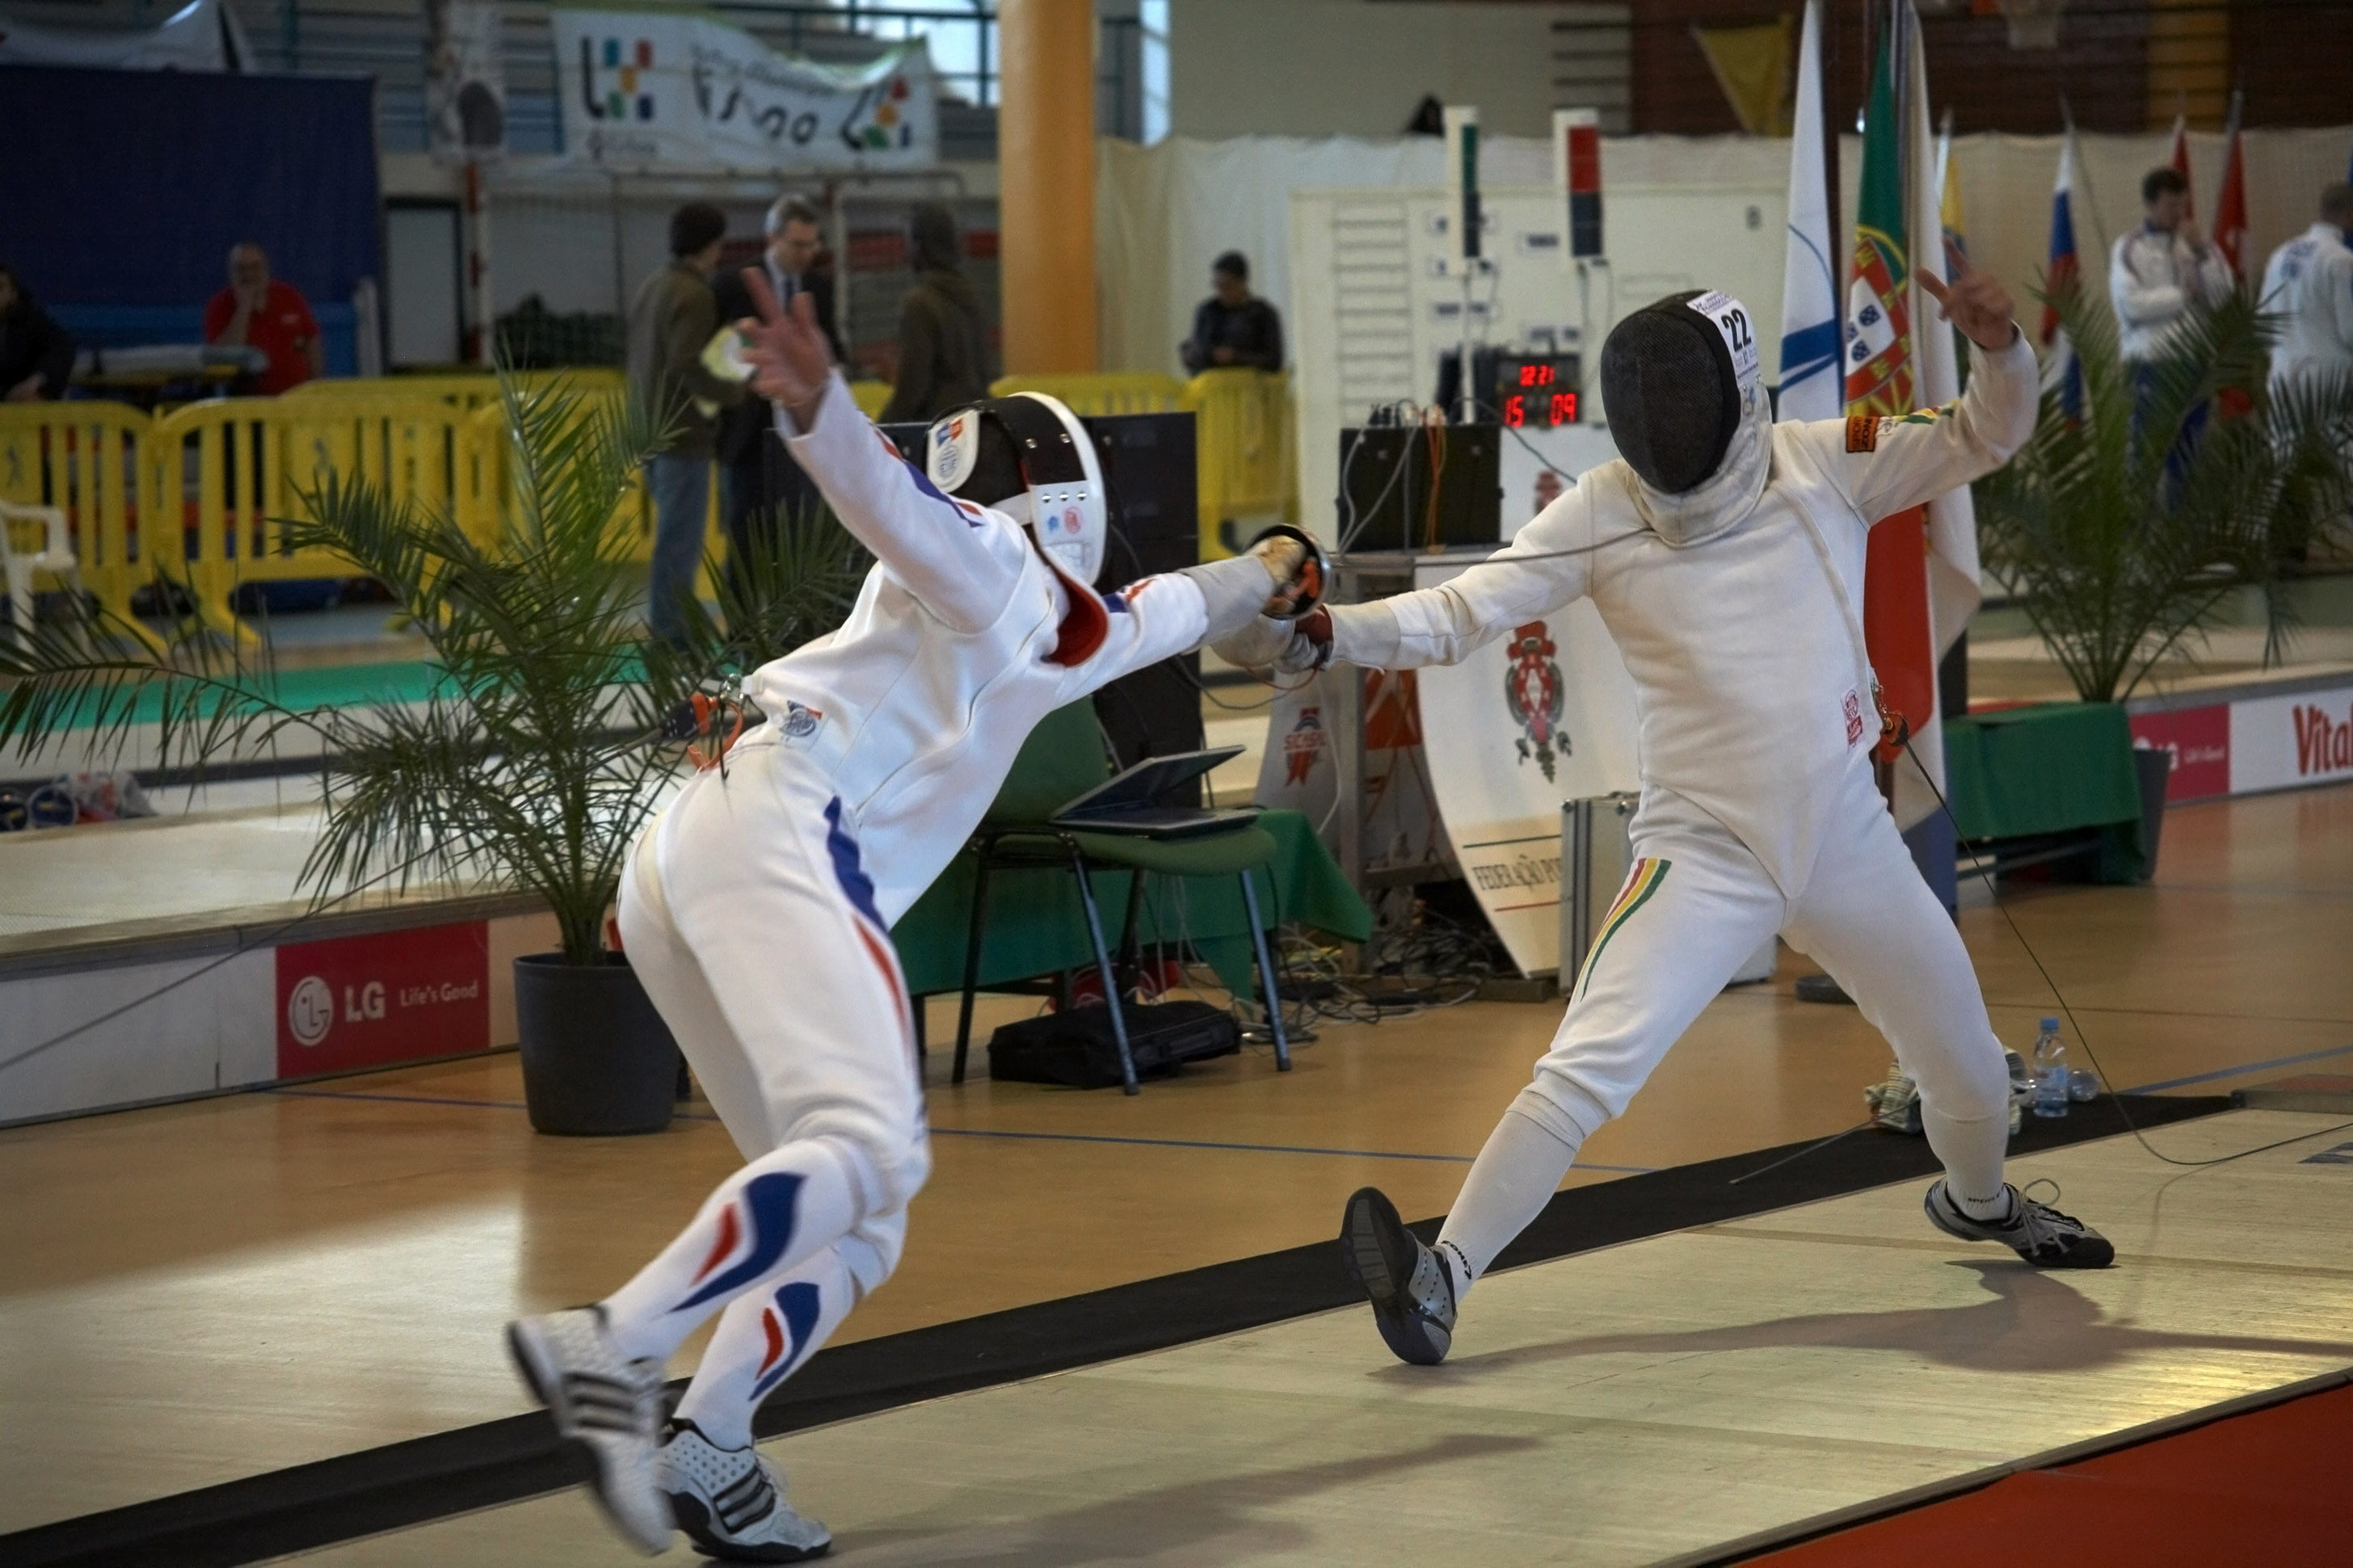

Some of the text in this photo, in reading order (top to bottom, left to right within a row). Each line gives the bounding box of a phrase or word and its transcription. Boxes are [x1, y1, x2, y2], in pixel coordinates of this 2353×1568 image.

[1721, 308, 1752, 352] 22
[1550, 393, 1576, 425] 09
[344, 981, 386, 1023] LG
